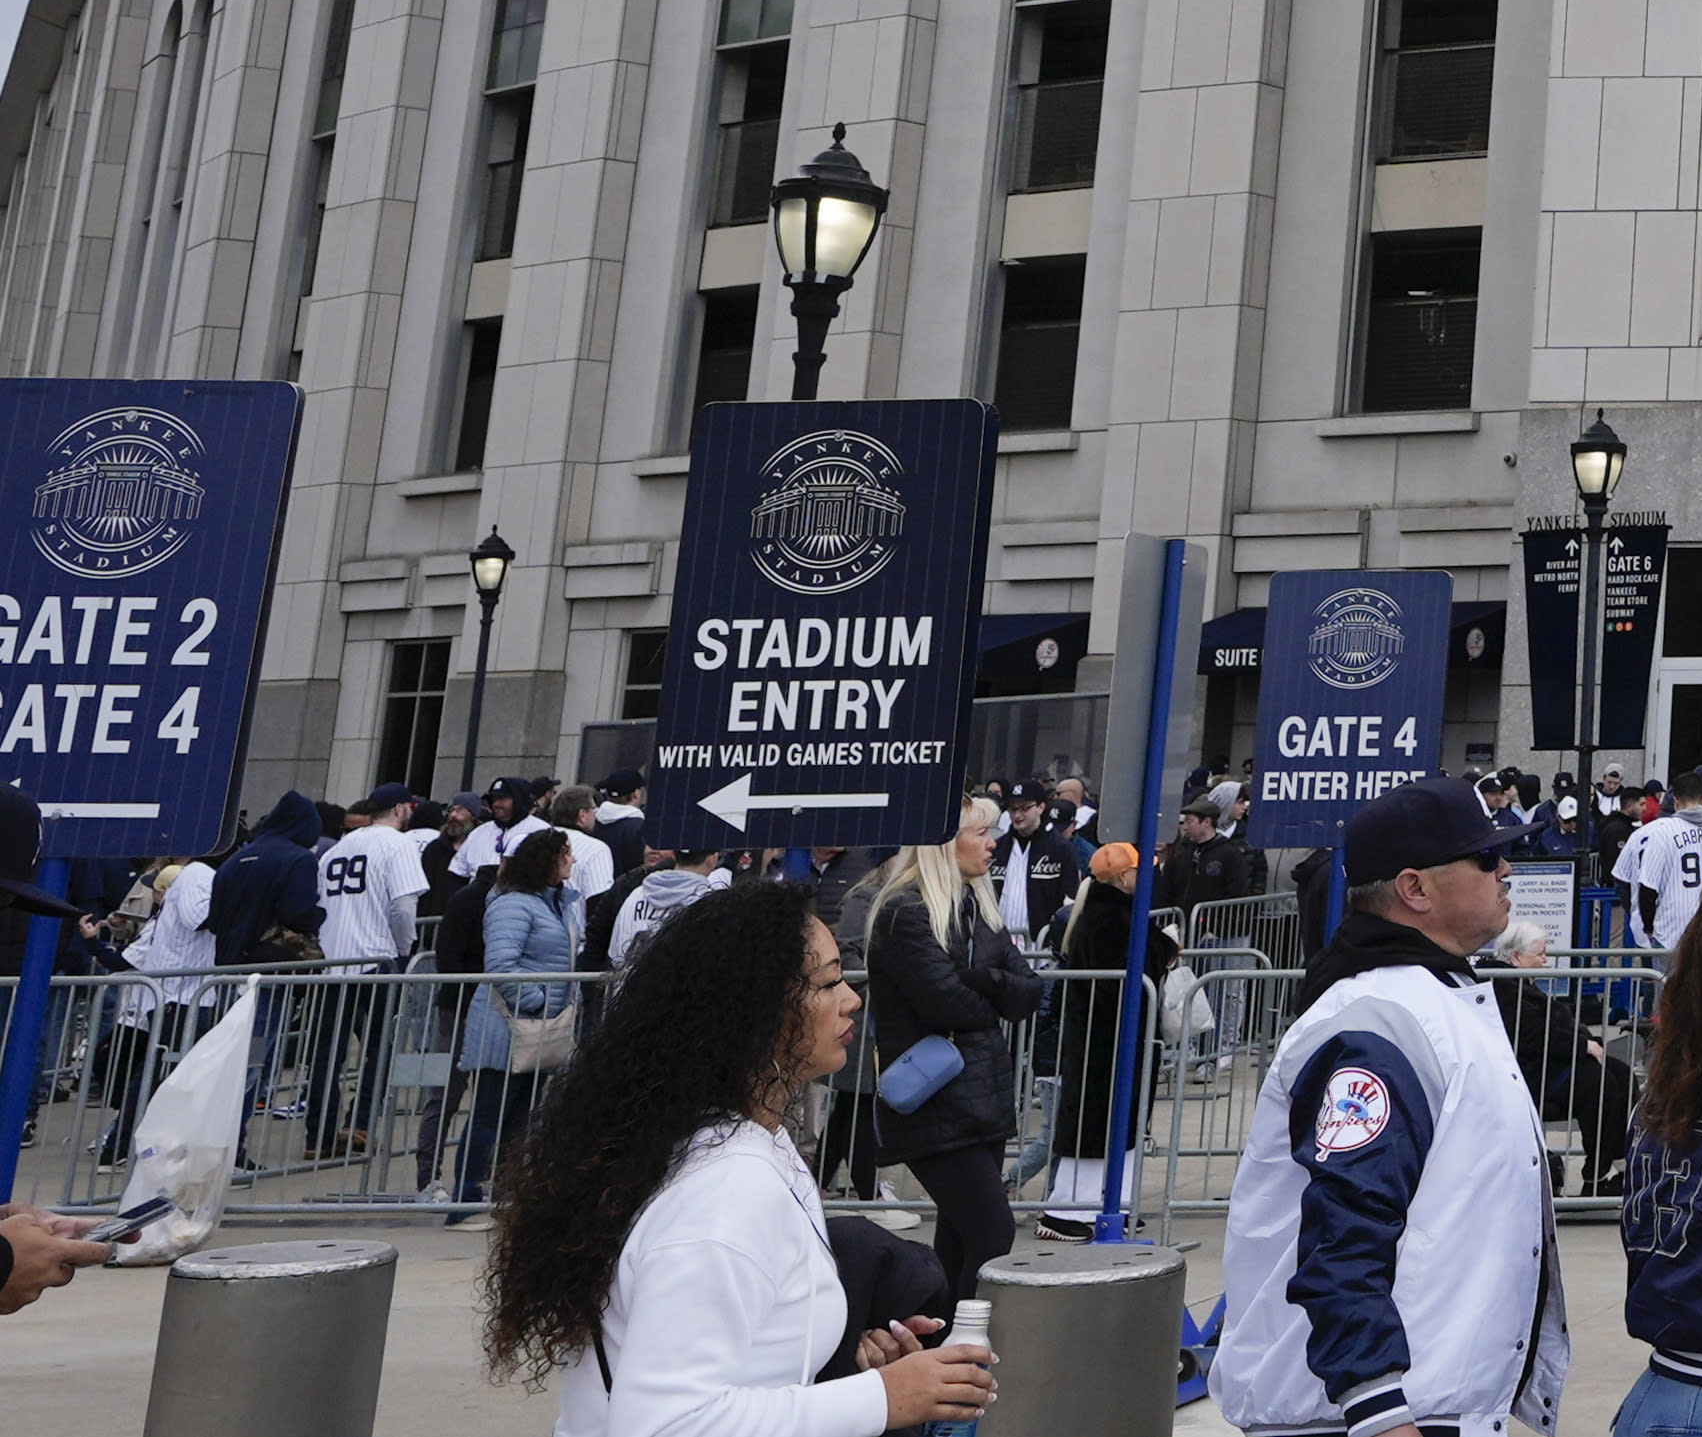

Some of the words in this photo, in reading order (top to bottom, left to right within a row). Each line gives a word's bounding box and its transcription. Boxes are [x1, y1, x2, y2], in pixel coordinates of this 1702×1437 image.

[61, 419, 192, 459] YANKEE
[772, 442, 891, 480] YANKEE
[1527, 515, 1581, 531] YANKEE
[1610, 511, 1666, 527] STADIUM
[45, 522, 178, 569] STADIUM
[763, 543, 885, 584] STADIUM
[1608, 556, 1642, 572] GATE
[1644, 556, 1652, 571] 6
[171, 597, 218, 666] 2
[693, 616, 933, 671] STADIUM
[1215, 648, 1258, 667] SUITE
[0, 684, 141, 753] ATE
[157, 686, 200, 754] 4
[727, 679, 906, 732] ENTRY
[658, 745, 712, 768] WITH
[719, 744, 781, 767] VALID
[786, 742, 864, 766] GAMES
[870, 741, 946, 764] TICKET
[1278, 715, 1383, 758] GATE
[1393, 717, 1418, 757] 4
[1262, 771, 1349, 801] ENTER
[326, 854, 368, 897] 99
